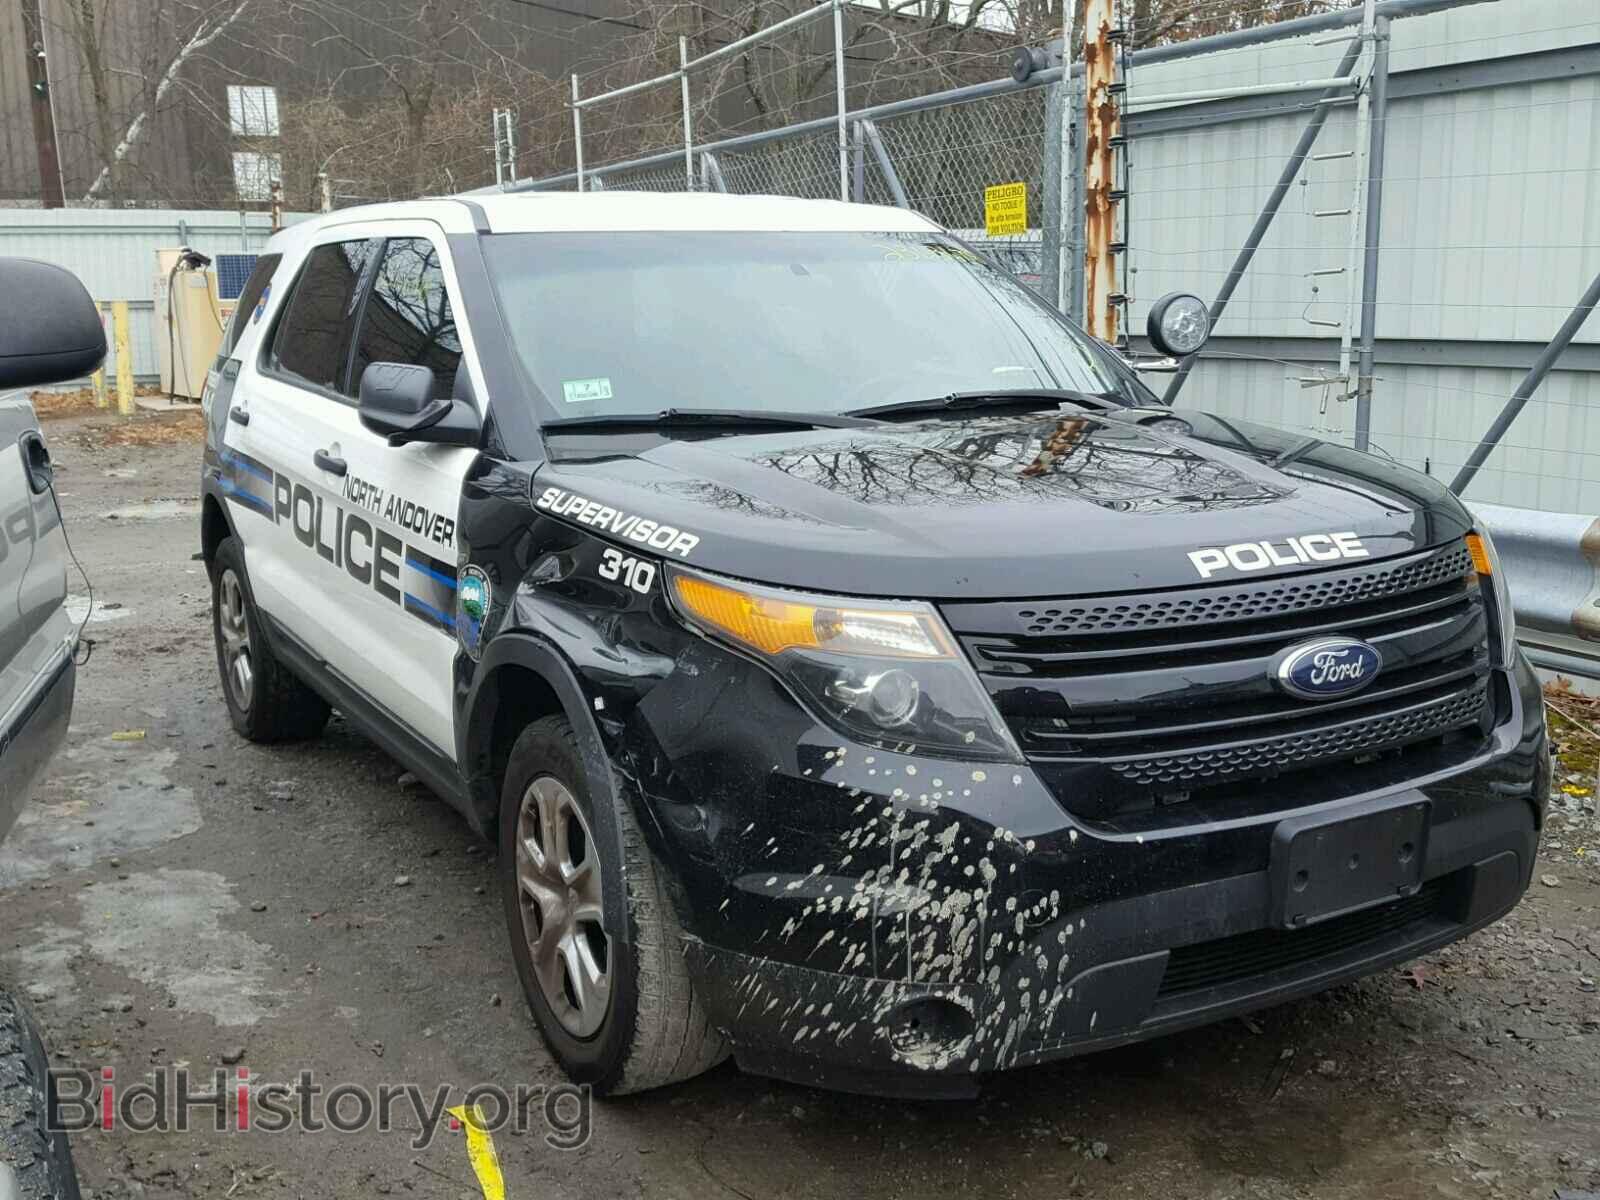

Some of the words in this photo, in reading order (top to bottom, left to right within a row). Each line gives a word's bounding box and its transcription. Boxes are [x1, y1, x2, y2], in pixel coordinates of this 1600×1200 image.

[986, 186, 1024, 200] PELIGRO
[342, 473, 384, 514] NORTH
[384, 494, 456, 547] ANDOVER
[536, 487, 700, 557] SUPERVISOR
[275, 471, 403, 606] POLICE
[1187, 531, 1371, 578] POLICE
[598, 548, 656, 595] 310
[1311, 648, 1365, 685] Ford
